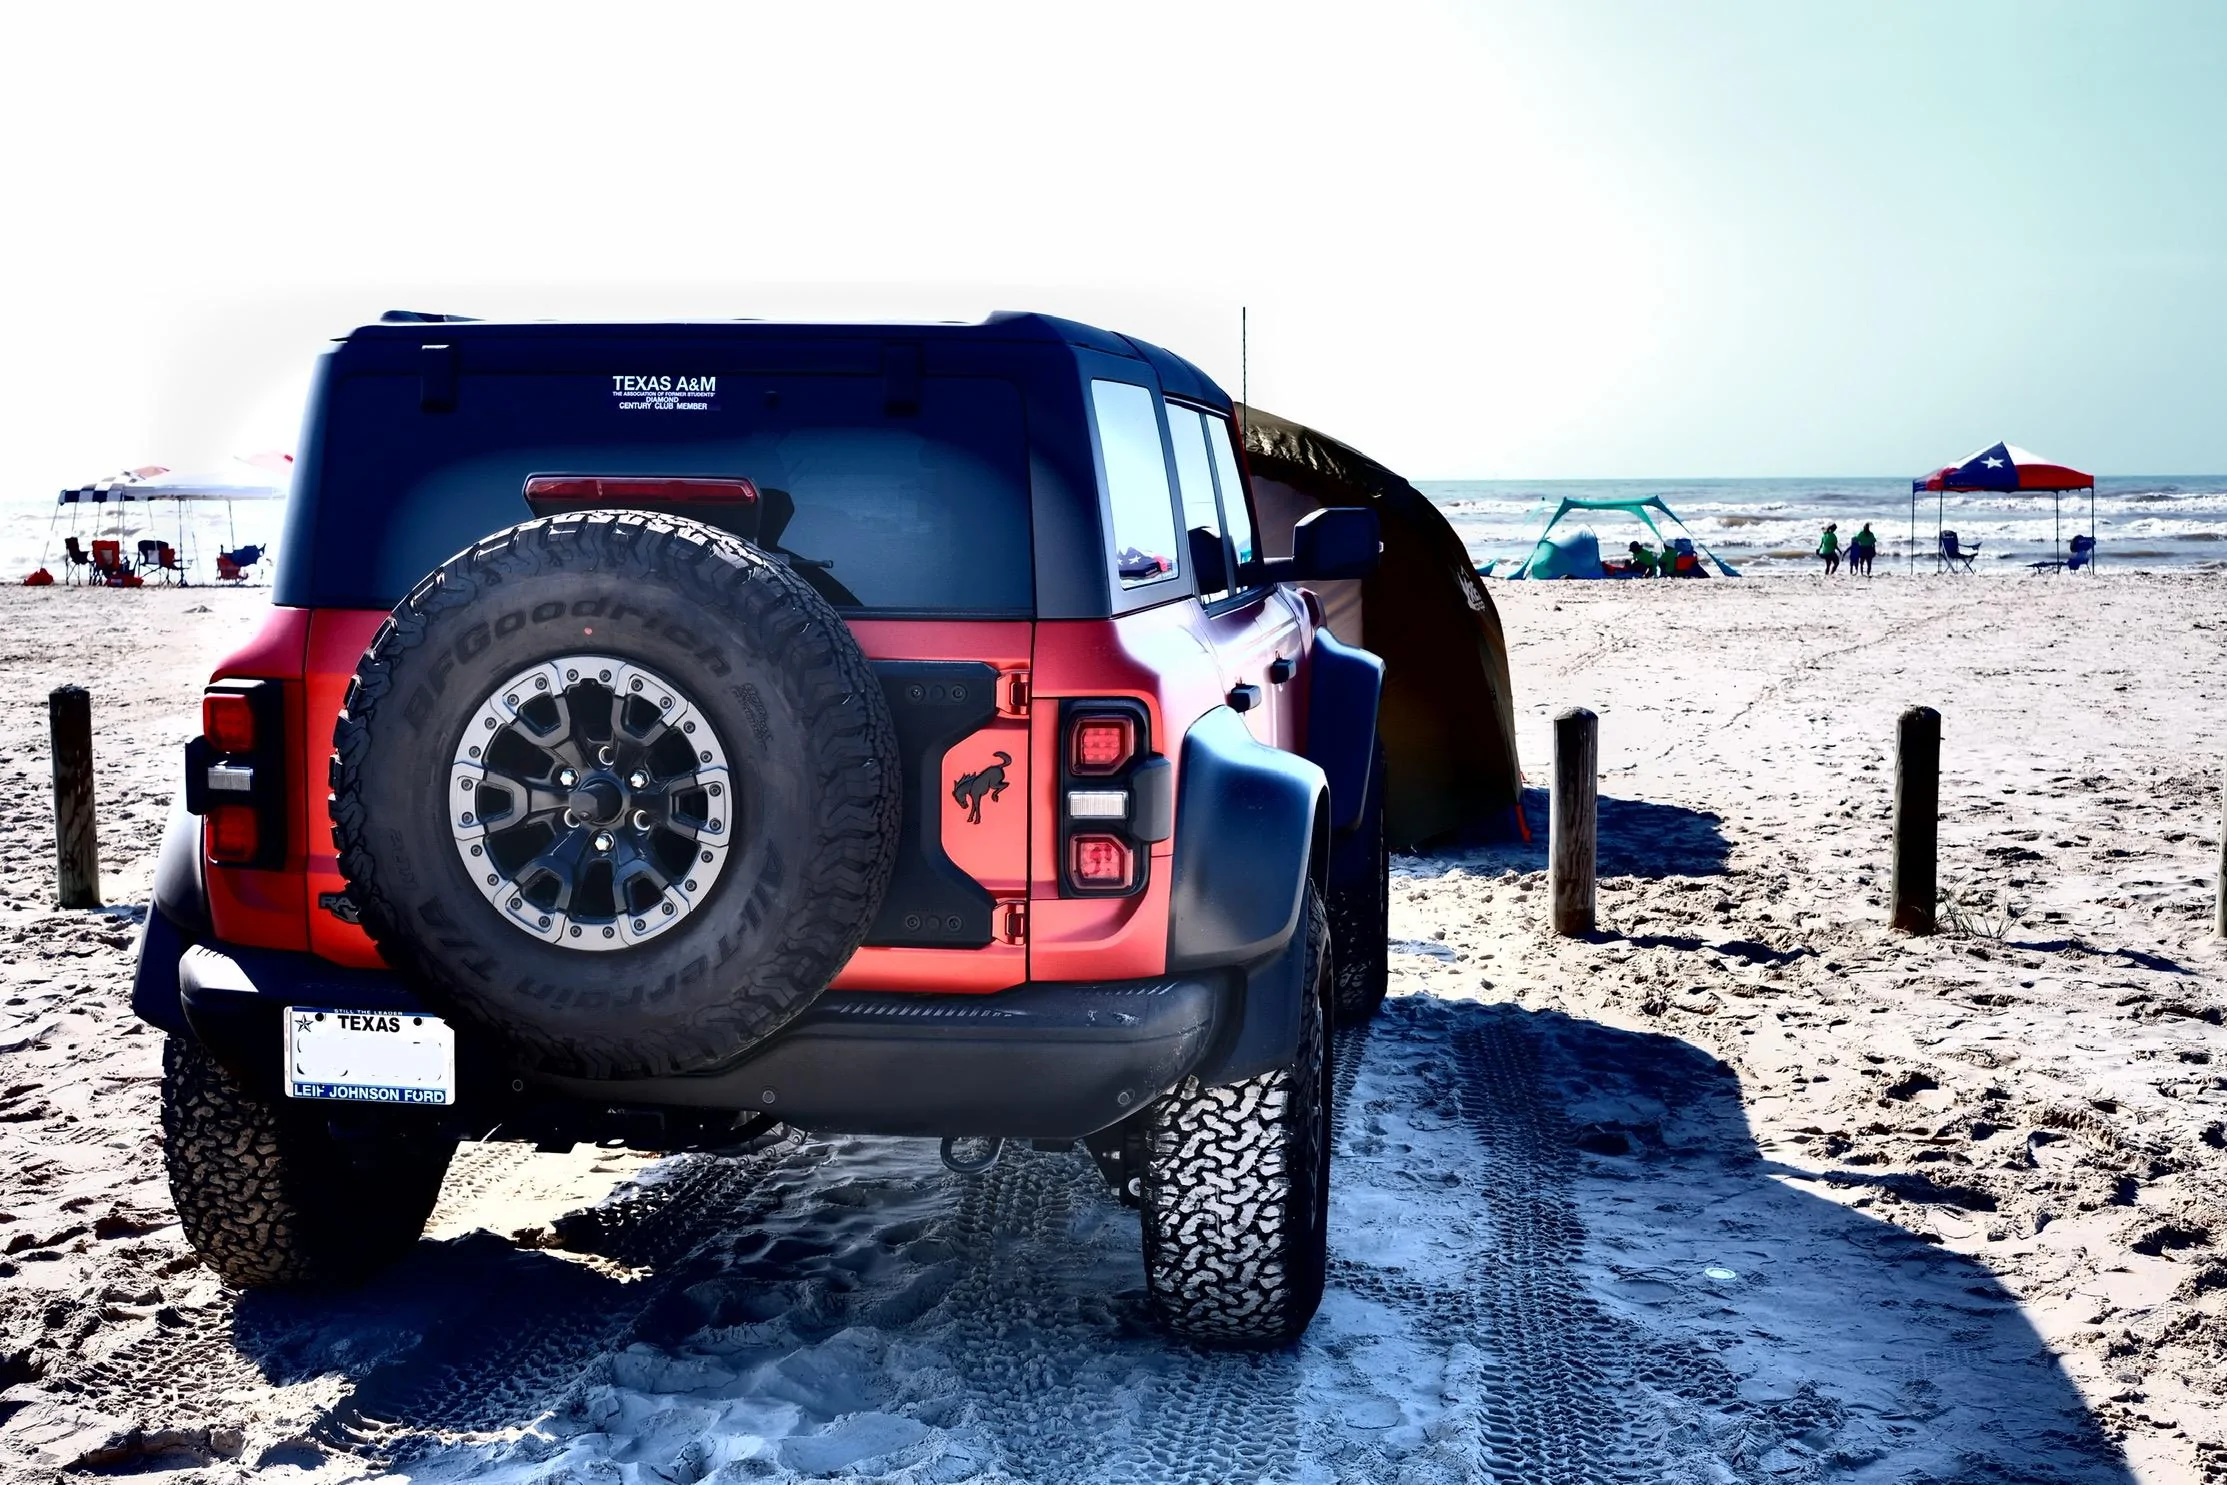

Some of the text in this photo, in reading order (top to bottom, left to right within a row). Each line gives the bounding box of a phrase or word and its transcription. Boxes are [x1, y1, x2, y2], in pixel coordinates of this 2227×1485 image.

[612, 375, 716, 392] TEXAS A&M
[619, 402, 708, 410] CENTURY CLUB MEMBER
[403, 597, 733, 732] BFGoodrich
[337, 1014, 401, 1033] TEXAS
[294, 1084, 445, 1103] LEIF JOHNSON FORD
